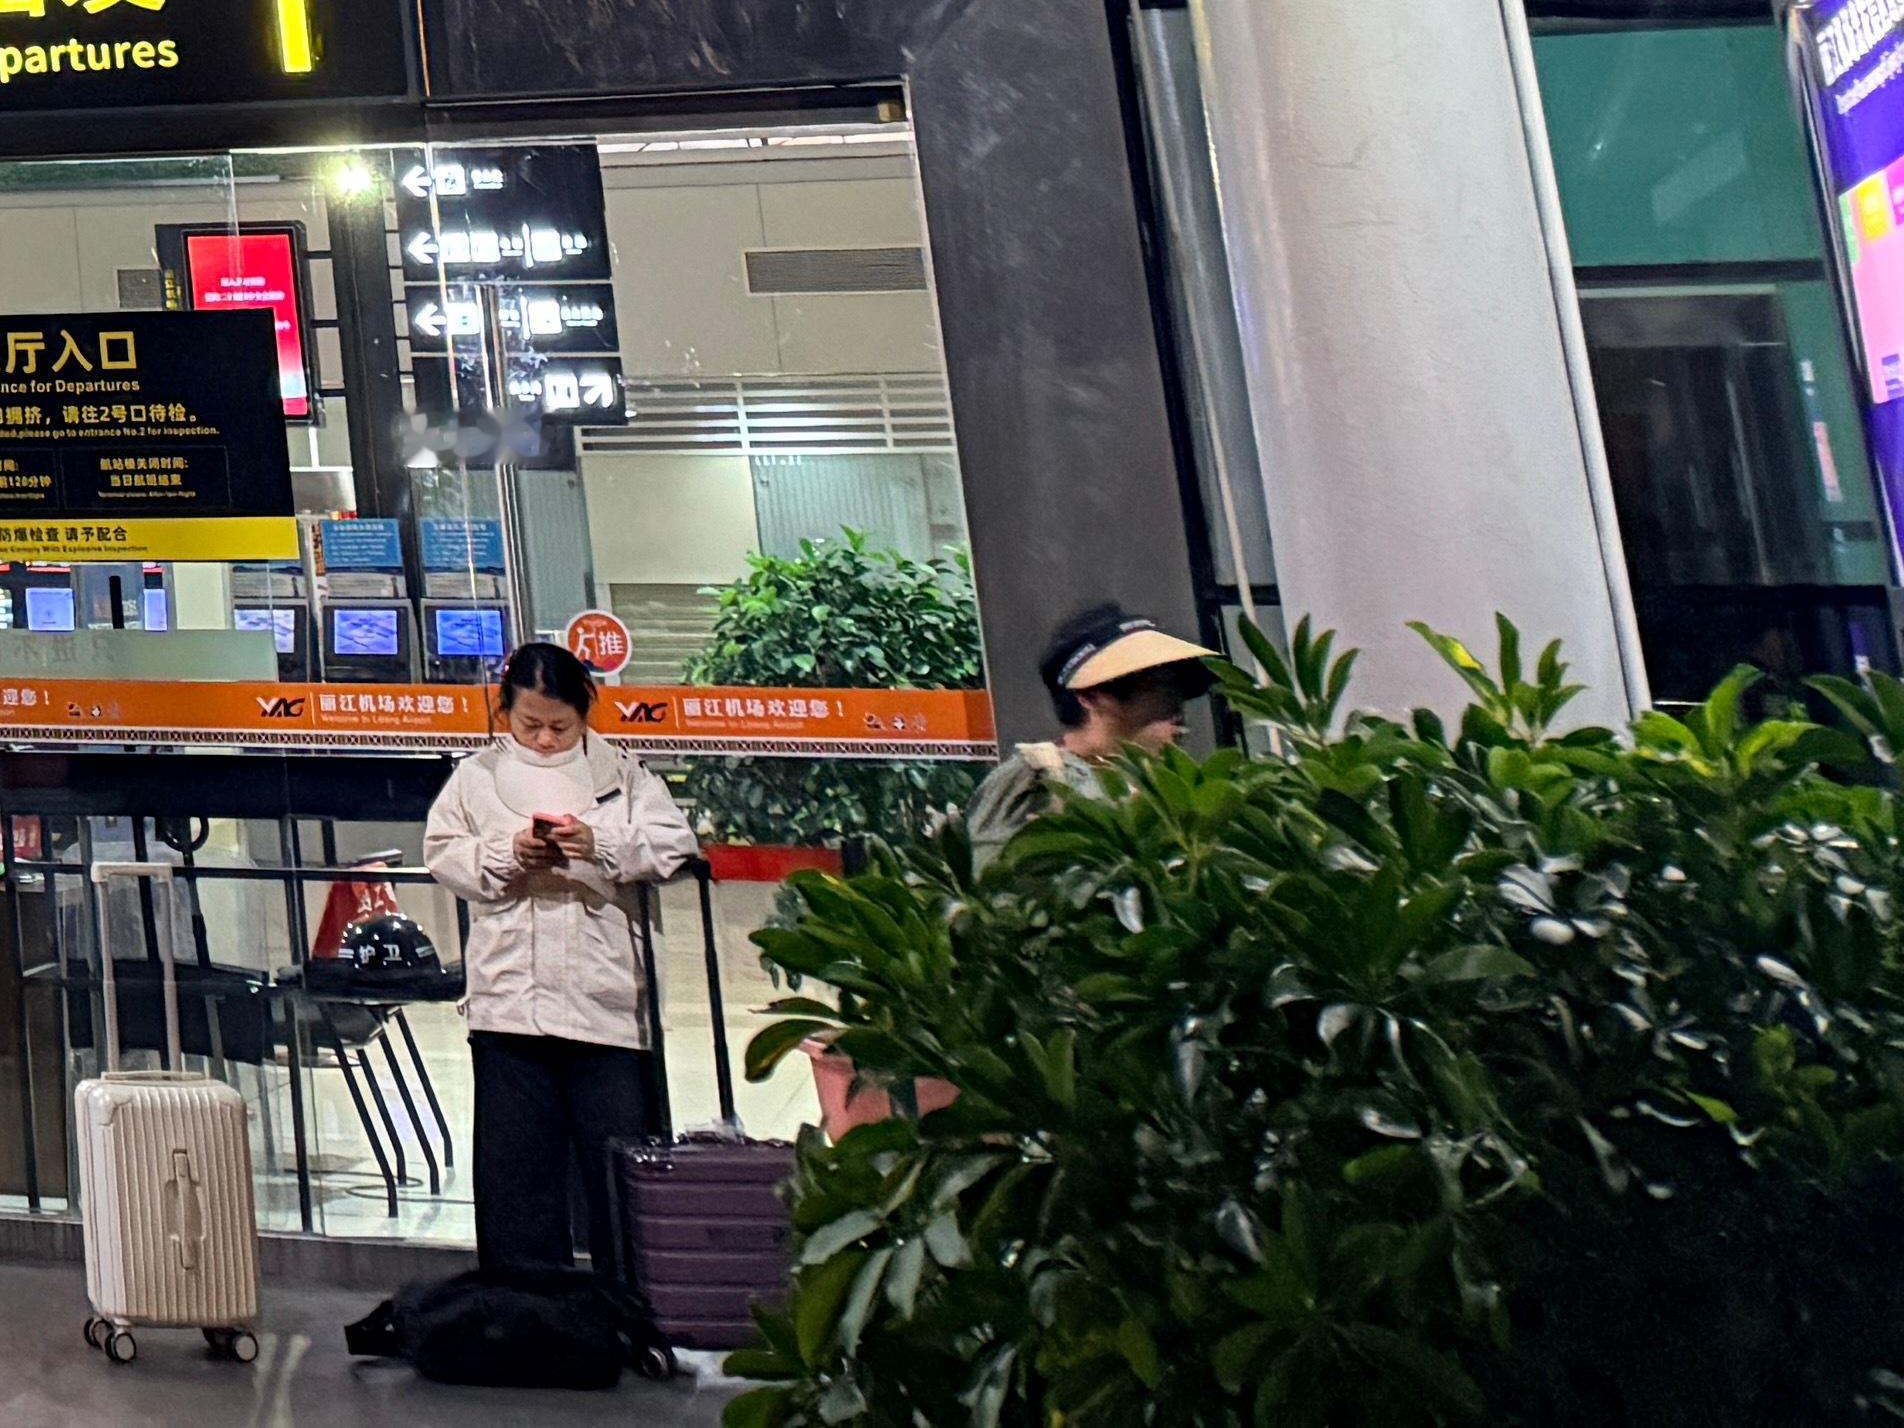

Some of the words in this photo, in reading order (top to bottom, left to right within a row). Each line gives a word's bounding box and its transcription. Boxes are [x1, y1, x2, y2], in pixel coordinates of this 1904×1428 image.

[30, 380, 52, 393] for
[55, 379, 140, 395] Departures
[65, 525, 128, 542] 请予配合
[598, 630, 624, 655] 推
[256, 696, 306, 718] YAC
[318, 693, 469, 715] 丽江机场欢迎您！
[614, 701, 669, 724] YAC
[682, 697, 844, 719] 丽江机场欢迎您！
